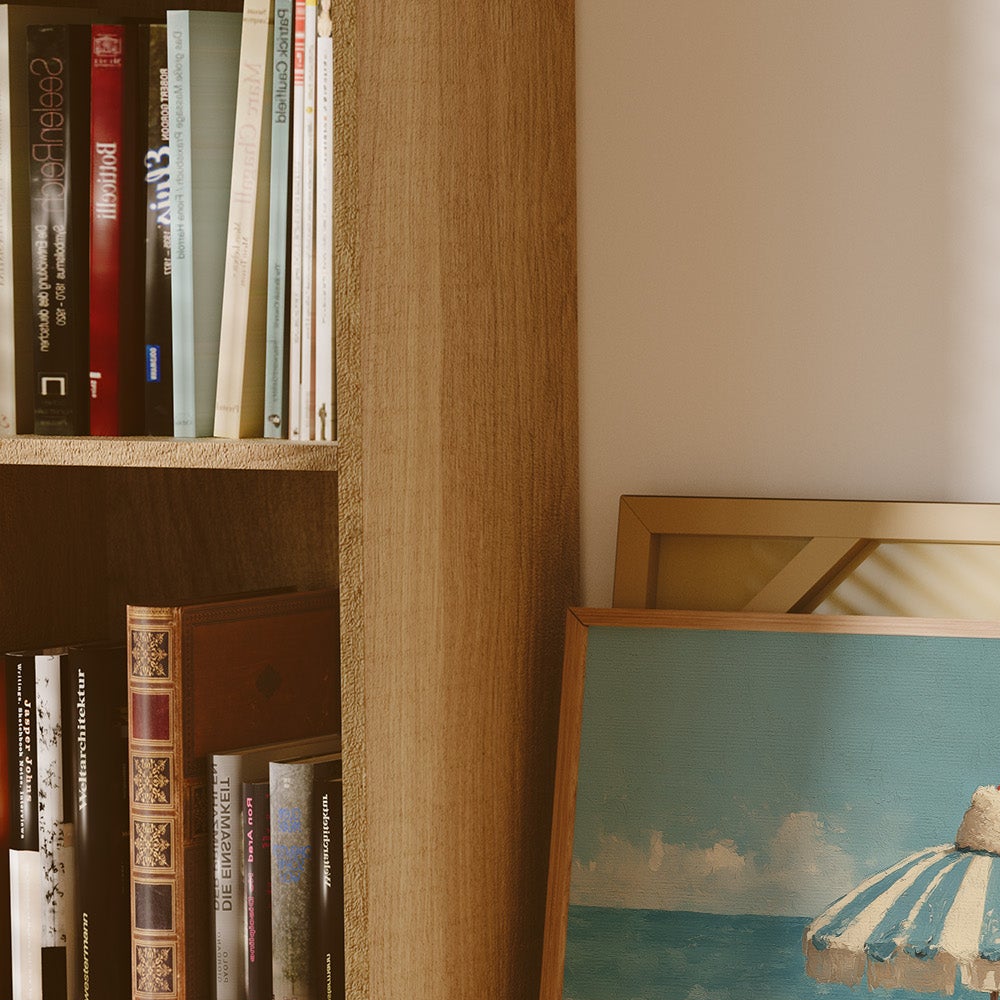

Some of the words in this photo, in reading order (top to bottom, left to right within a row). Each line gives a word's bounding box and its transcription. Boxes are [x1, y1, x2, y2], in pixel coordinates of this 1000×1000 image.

[23, 699, 32, 752] Jasper
[77, 669, 87, 811] Weltarchitektur
[24, 756, 33, 803] Johns
